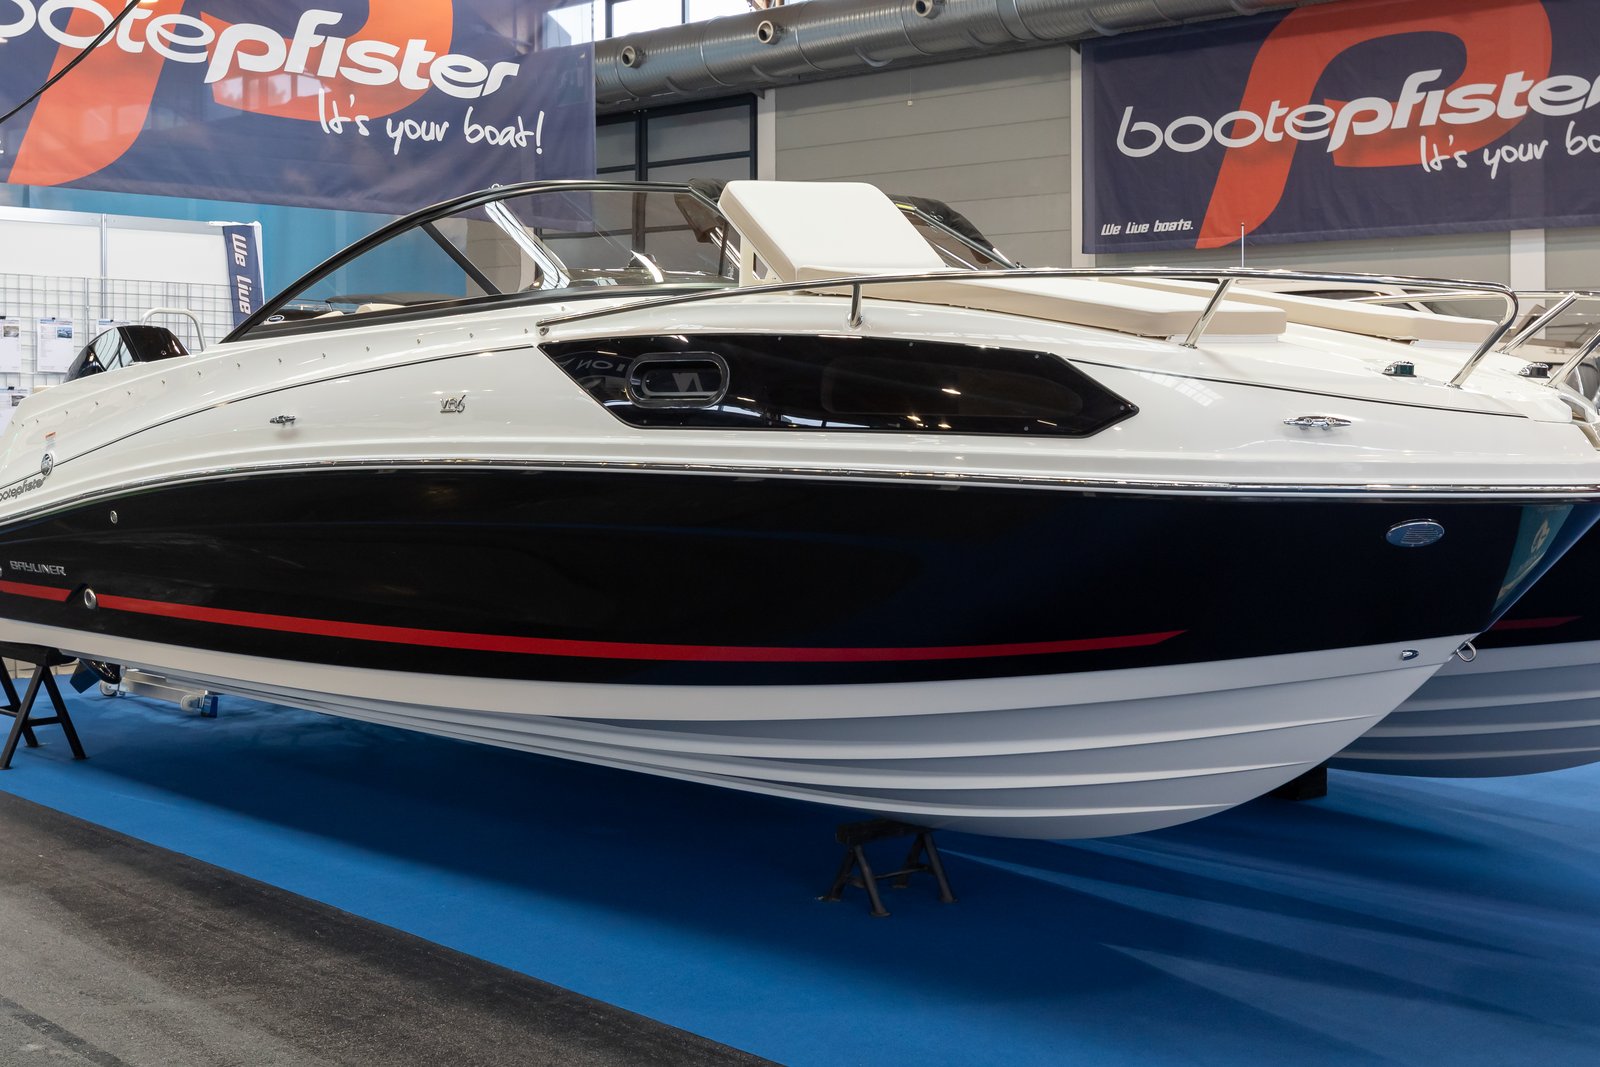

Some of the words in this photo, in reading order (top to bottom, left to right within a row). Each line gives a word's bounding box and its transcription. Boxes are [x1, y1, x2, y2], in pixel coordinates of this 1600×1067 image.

[318, 88, 370, 136] It's
[386, 118, 450, 155] your
[463, 106, 545, 155] boat!
[1420, 135, 1468, 173] It's
[1483, 140, 1549, 180] your
[1101, 223, 1121, 236] We
[1153, 218, 1194, 233] boats.
[231, 233, 248, 267] We
[9, 560, 67, 577] BAYLINER
